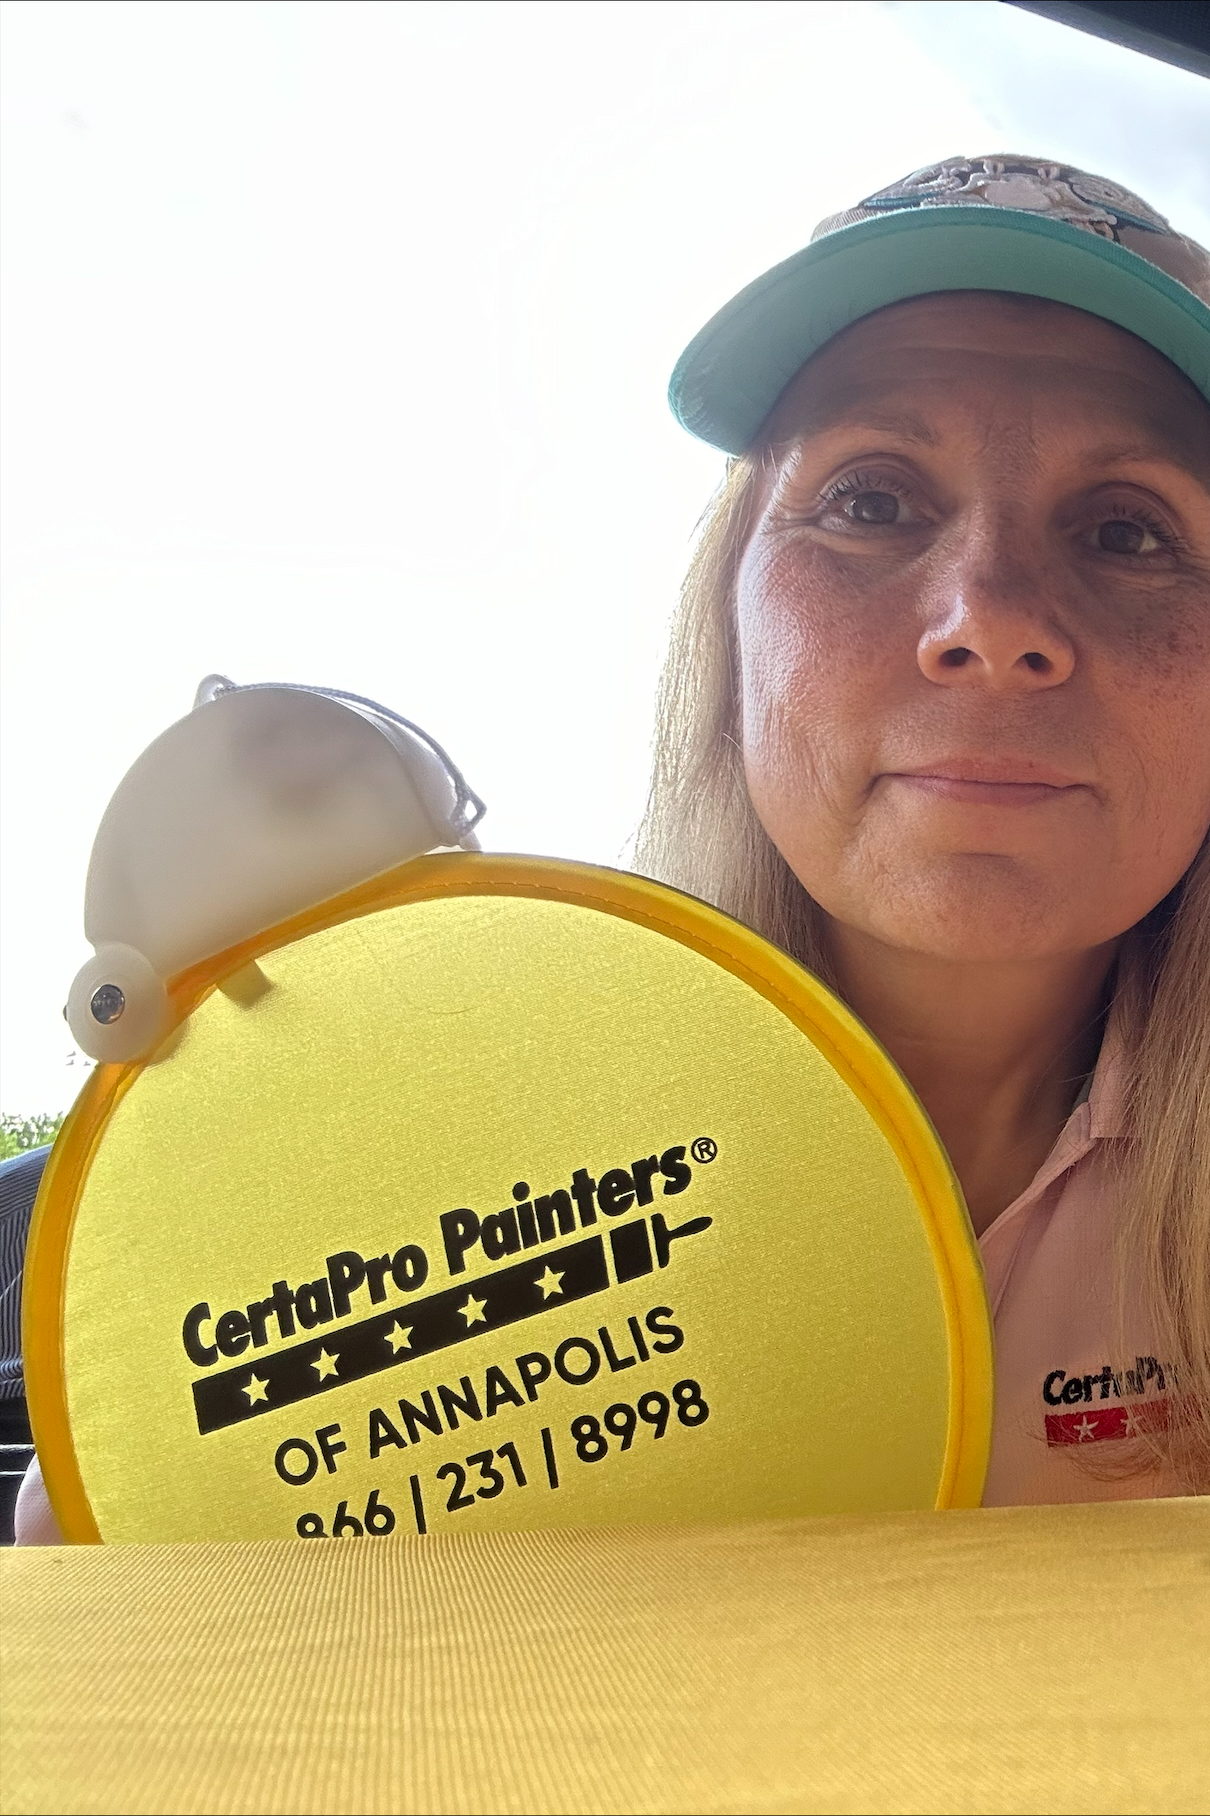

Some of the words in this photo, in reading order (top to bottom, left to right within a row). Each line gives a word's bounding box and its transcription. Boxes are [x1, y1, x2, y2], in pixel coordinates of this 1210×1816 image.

[182, 1244, 429, 1367] CertaPro
[274, 1423, 347, 1486] OF
[369, 1306, 685, 1460] ANNAPOLIS
[436, 1441, 528, 1513] 231
[570, 1378, 710, 1463] 8998
